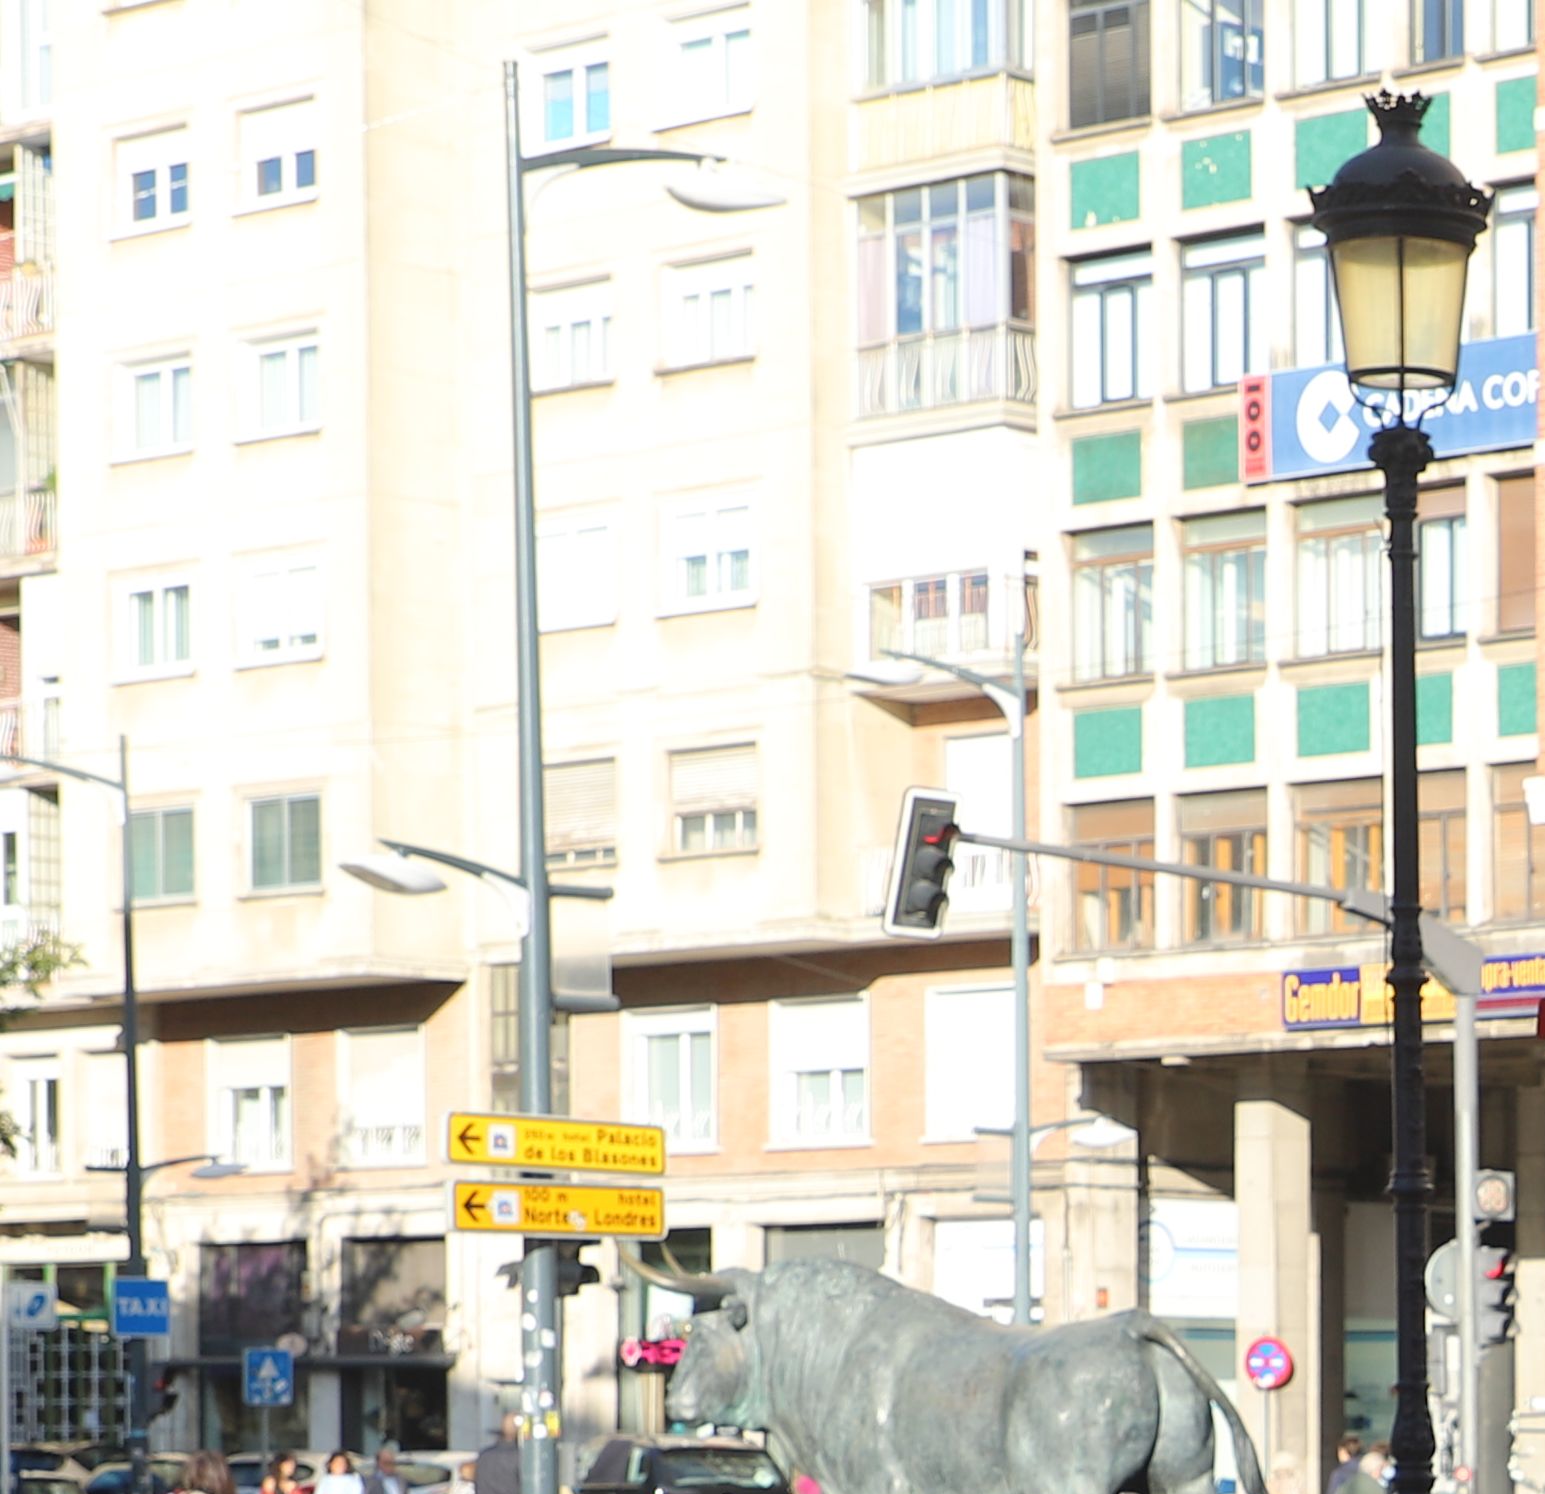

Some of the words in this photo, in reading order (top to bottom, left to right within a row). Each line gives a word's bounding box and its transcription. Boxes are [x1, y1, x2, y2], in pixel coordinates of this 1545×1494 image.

[1363, 381, 1478, 428] CADENA
[1284, 972, 1360, 1023] Gemdor
[597, 1128, 657, 1147] Palacio
[524, 1146, 544, 1161] de
[551, 1147, 575, 1162] los
[583, 1148, 657, 1167] Blasones
[617, 1192, 657, 1206] hotel
[524, 1207, 568, 1226] Norte
[594, 1210, 657, 1228] Londres
[117, 1297, 168, 1317] TAXI
